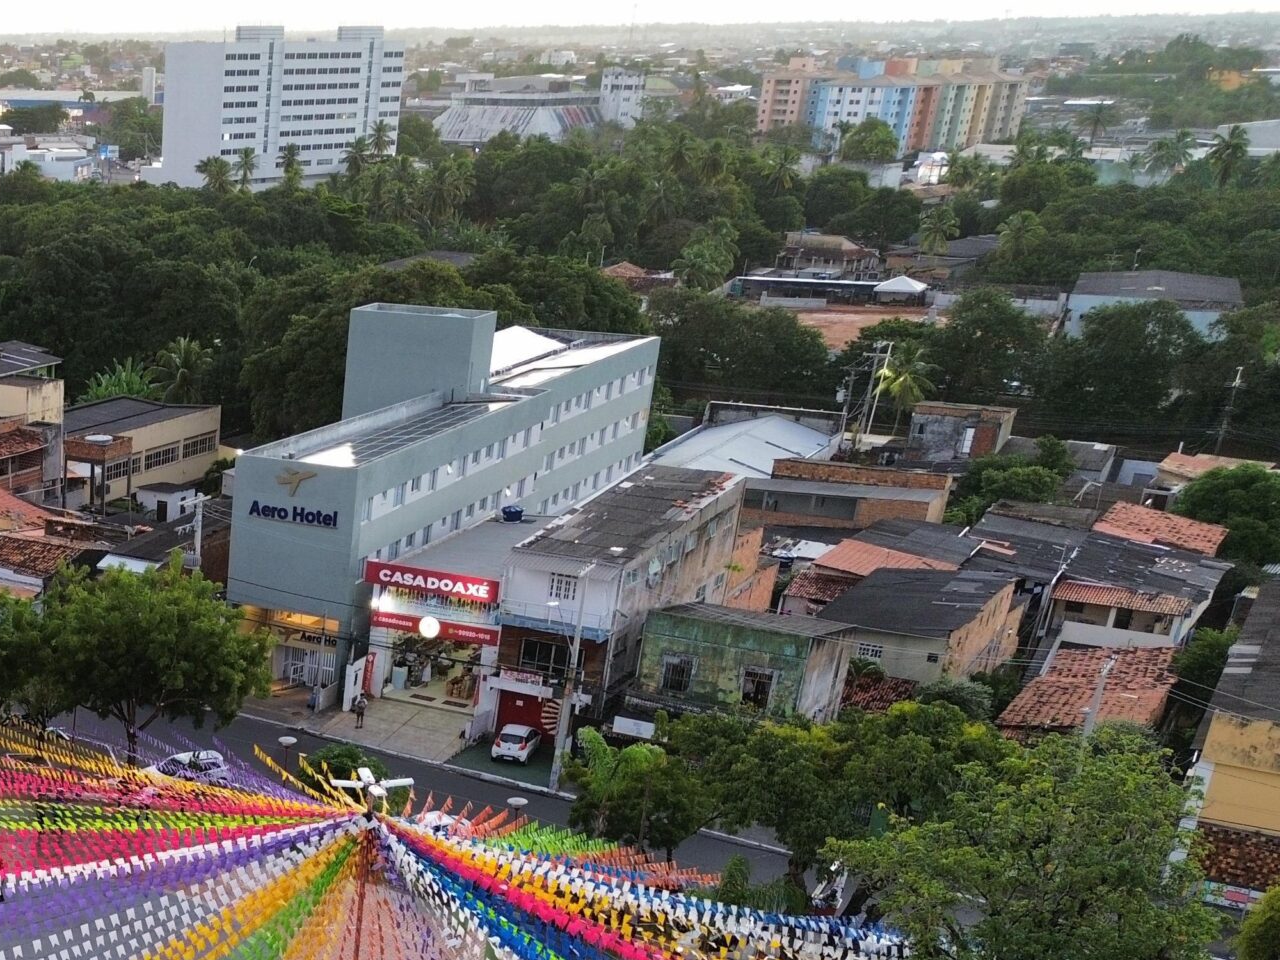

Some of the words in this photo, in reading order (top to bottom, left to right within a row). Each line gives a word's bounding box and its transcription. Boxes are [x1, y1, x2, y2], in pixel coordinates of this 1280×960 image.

[249, 500, 288, 520] Aero
[292, 506, 338, 527] Hotel
[379, 569, 490, 598] CASADOAXÉ
[300, 631, 322, 644] Aero
